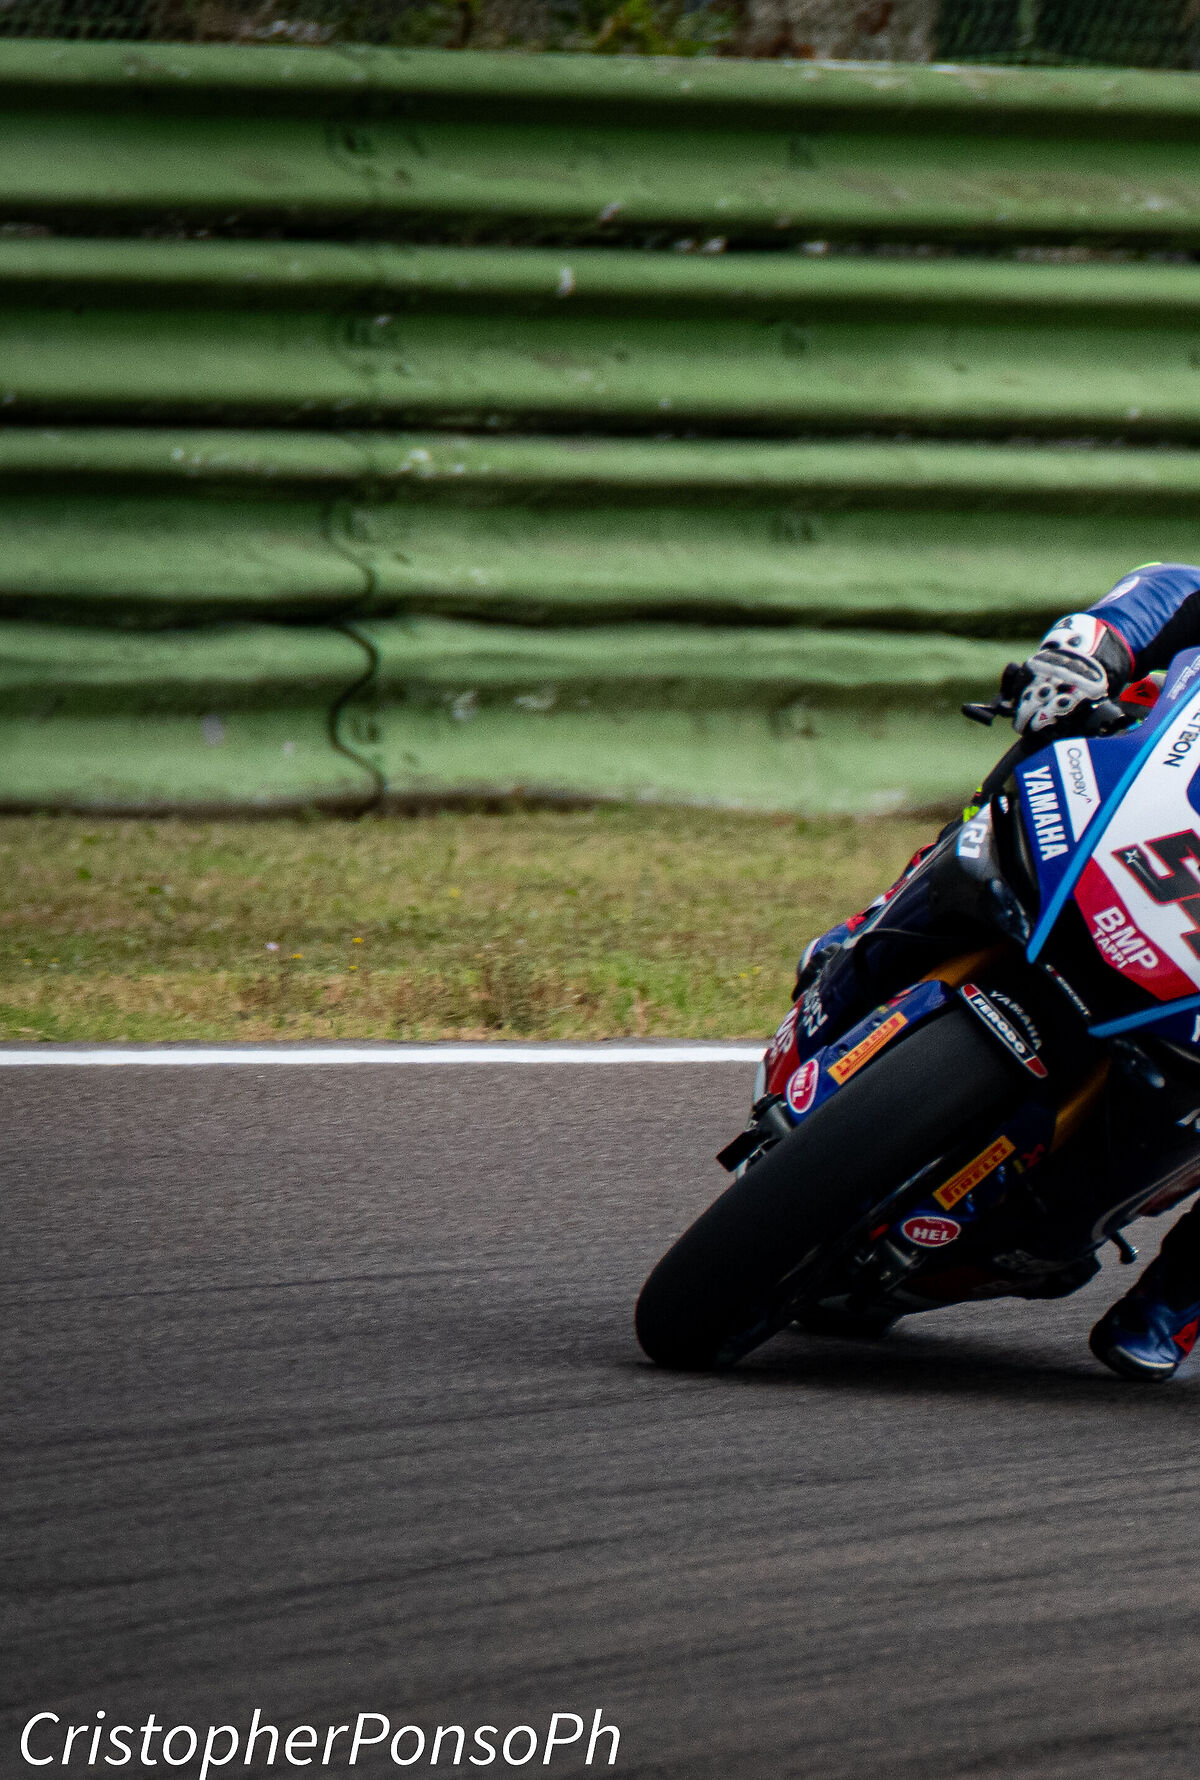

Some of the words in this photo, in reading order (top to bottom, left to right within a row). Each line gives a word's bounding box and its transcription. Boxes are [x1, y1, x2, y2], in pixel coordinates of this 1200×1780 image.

[1066, 747, 1091, 798] Corpay
[1023, 765, 1069, 862] YAMAHA
[1092, 928, 1129, 970] TAPPI
[1093, 905, 1159, 970] BMP
[912, 1226, 951, 1241] HEL
